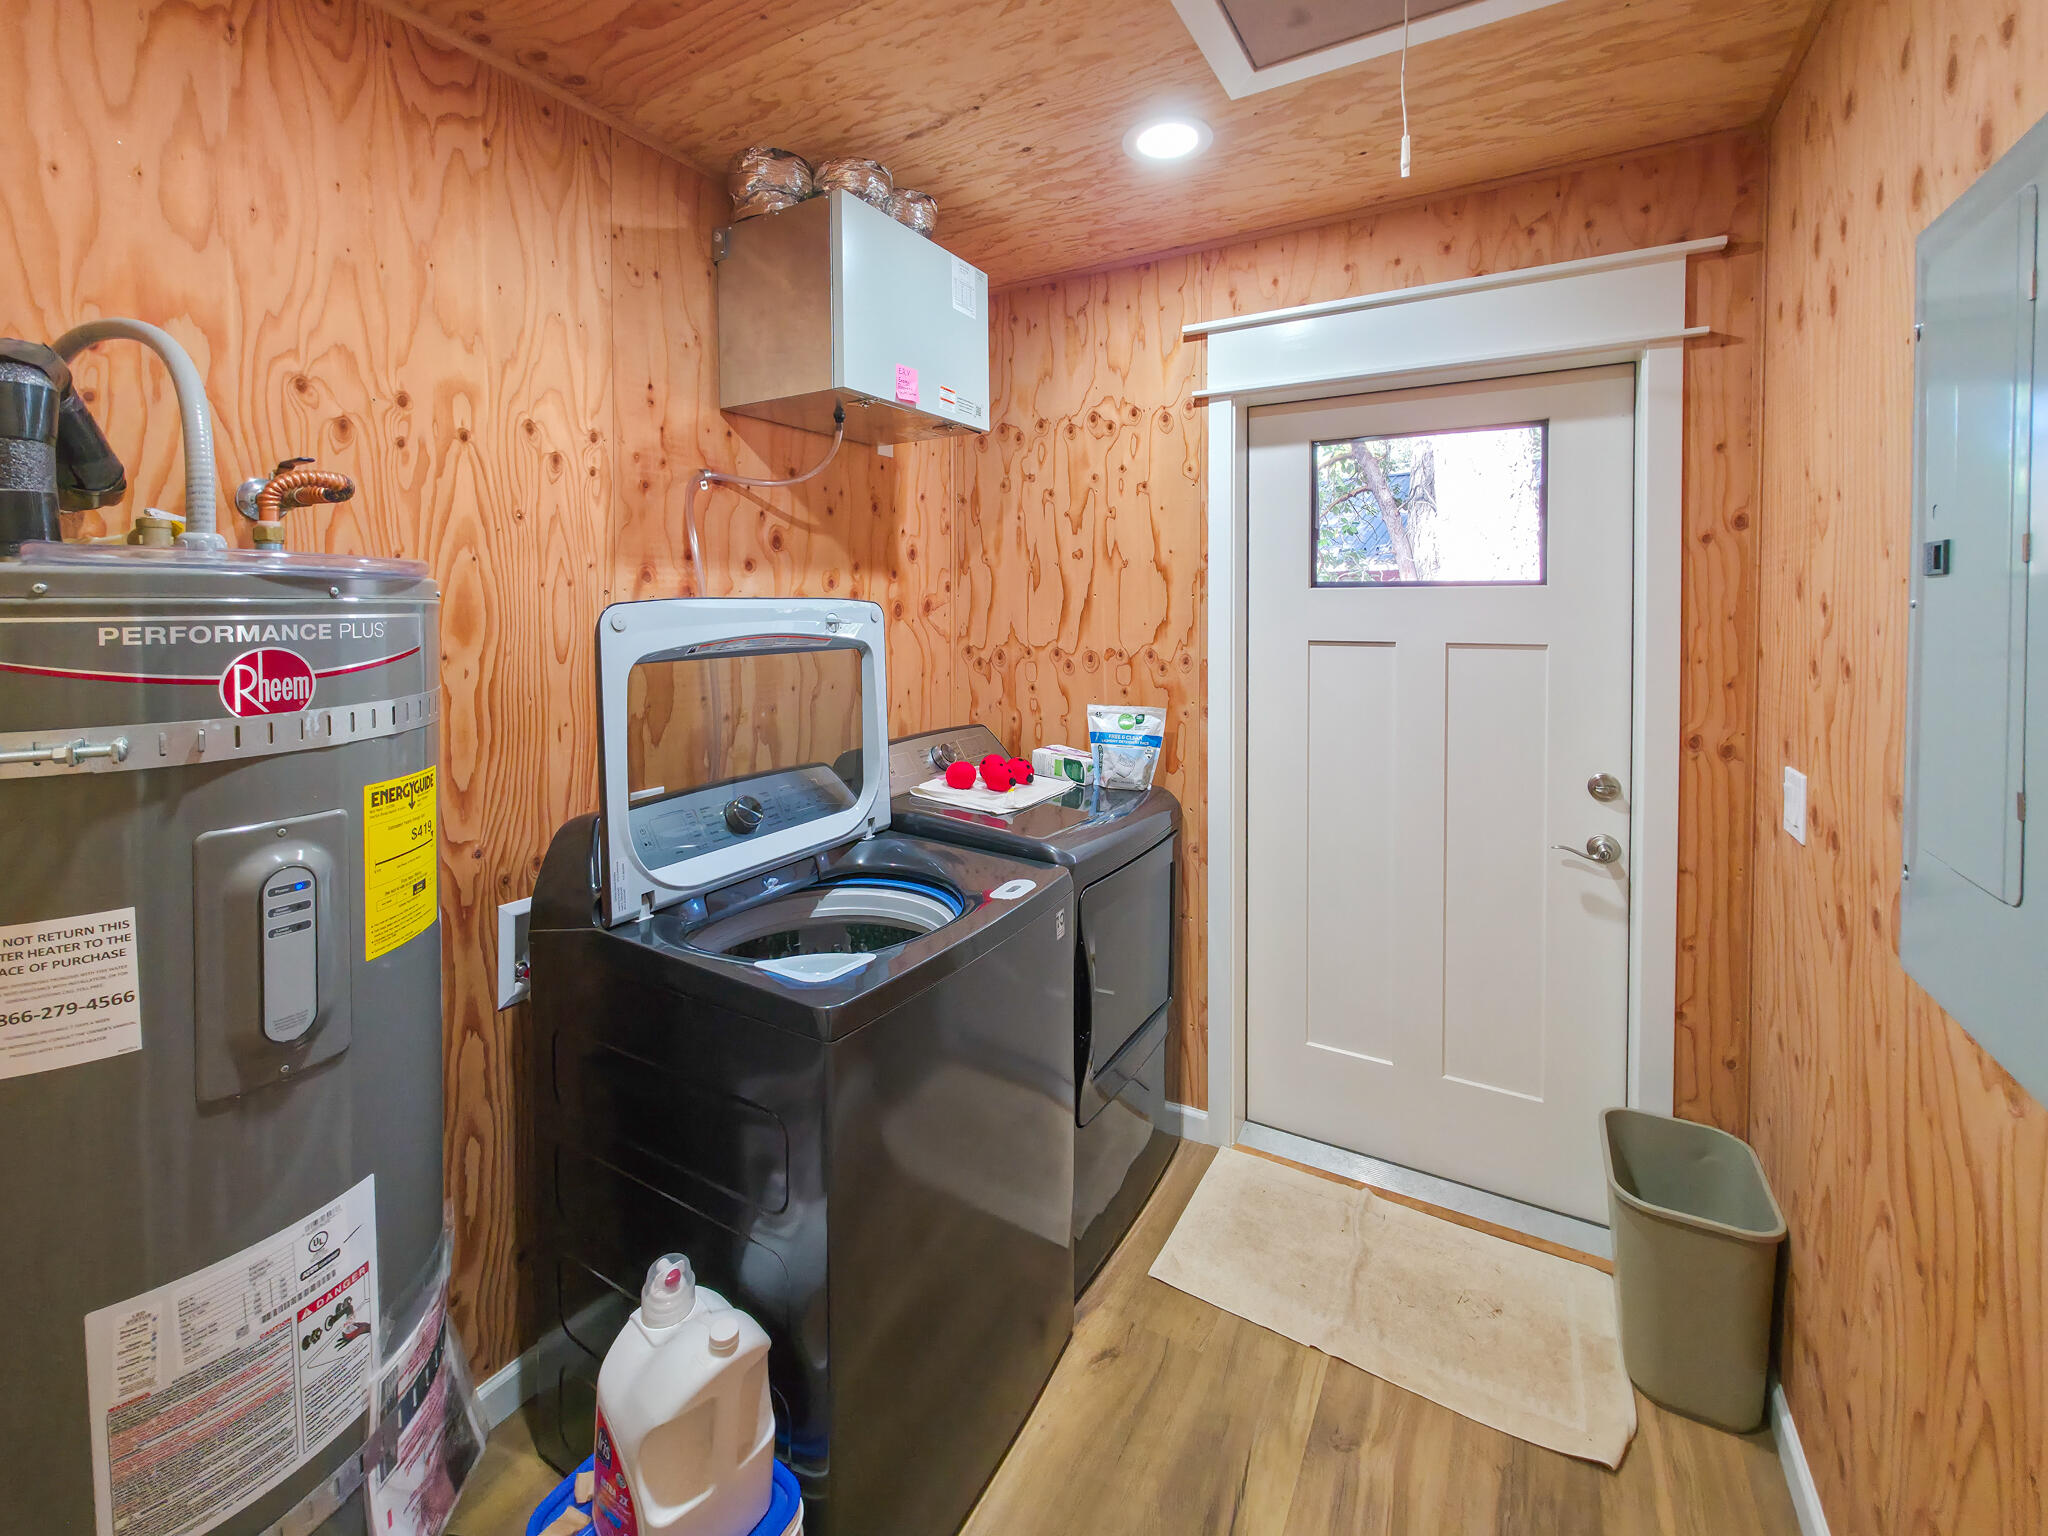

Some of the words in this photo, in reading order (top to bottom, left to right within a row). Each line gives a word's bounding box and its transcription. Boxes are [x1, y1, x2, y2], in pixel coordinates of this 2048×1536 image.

[98, 623, 332, 647] PERFORMANCE
[233, 651, 310, 713] Rheem
[370, 772, 434, 809] ENERGYGUIDE
[2, 935, 33, 948] NOT
[37, 926, 95, 943] RETURN
[98, 919, 130, 933] THIS
[27, 942, 81, 959] HEATER
[82, 938, 103, 949] TO
[106, 933, 132, 945] THE
[29, 962, 49, 973] OF
[52, 948, 127, 969] PURCHASE
[316, 1265, 367, 1308] DANGER
